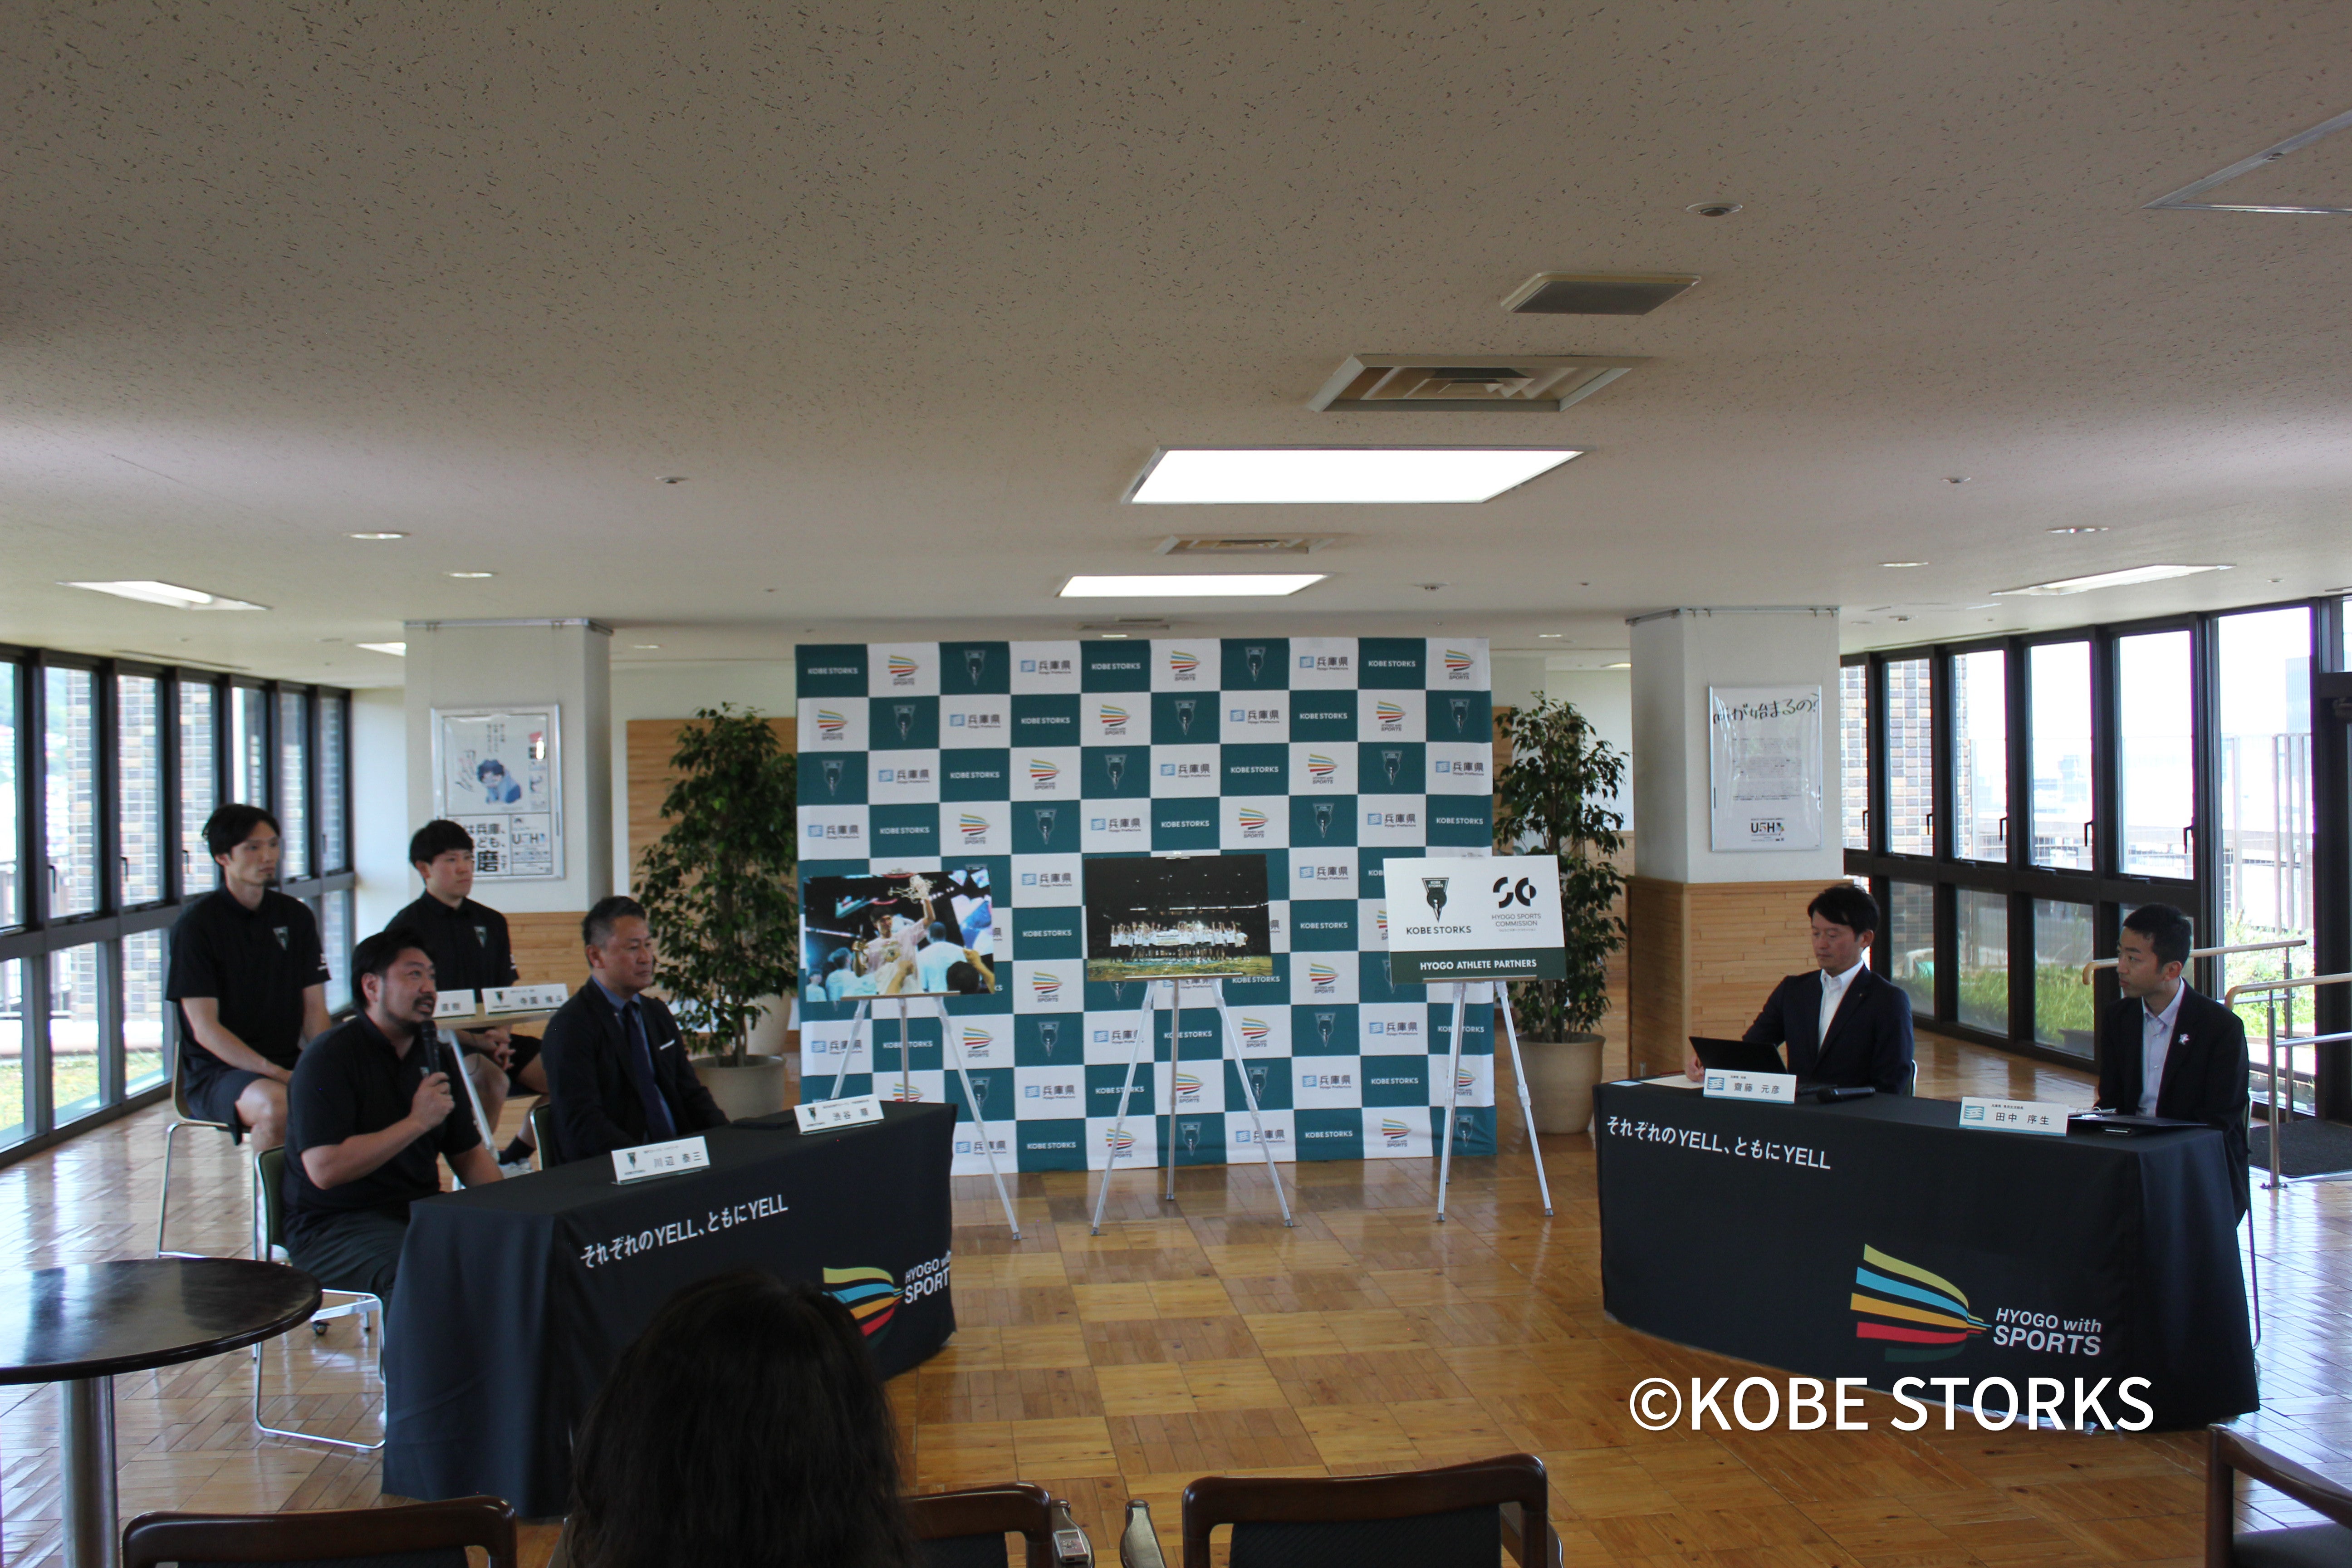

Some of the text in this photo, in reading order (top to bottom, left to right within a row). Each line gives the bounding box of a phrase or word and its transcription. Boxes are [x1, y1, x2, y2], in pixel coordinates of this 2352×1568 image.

[1039, 660, 1071, 671] 兵庫県
[1317, 657, 1348, 666] 兵庫県
[968, 714, 1000, 725] 兵庫県
[1248, 710, 1279, 720] 兵庫県
[1178, 764, 1210, 774] 兵庫県
[1453, 762, 1484, 772] 兵庫県
[897, 769, 929, 780] 兵庫県
[1109, 818, 1141, 828] 兵庫県
[1385, 814, 1416, 823] 兵庫県
[826, 824, 859, 836] 兵庫県
[472, 850, 499, 872] 磨
[1317, 867, 1348, 877] 兵庫県
[1039, 873, 1072, 884] 兵庫県
[1406, 926, 1472, 935] KOBE STORKS
[1420, 959, 1537, 970] HYOGO ATHLETE PARTNERS
[1387, 1022, 1417, 1032] 兵庫県
[1320, 1075, 1351, 1085] 兵庫県
[1043, 1085, 1075, 1096] 兵庫県
[1761, 1085, 1780, 1094] 元彦
[1995, 1112, 2018, 1122] 田中
[905, 1258, 939, 1284] HYOGO
[905, 1267, 950, 1304] SPORT
[1996, 1308, 2102, 1333] HYOGO with
[1993, 1325, 2102, 1356] SPORTS
